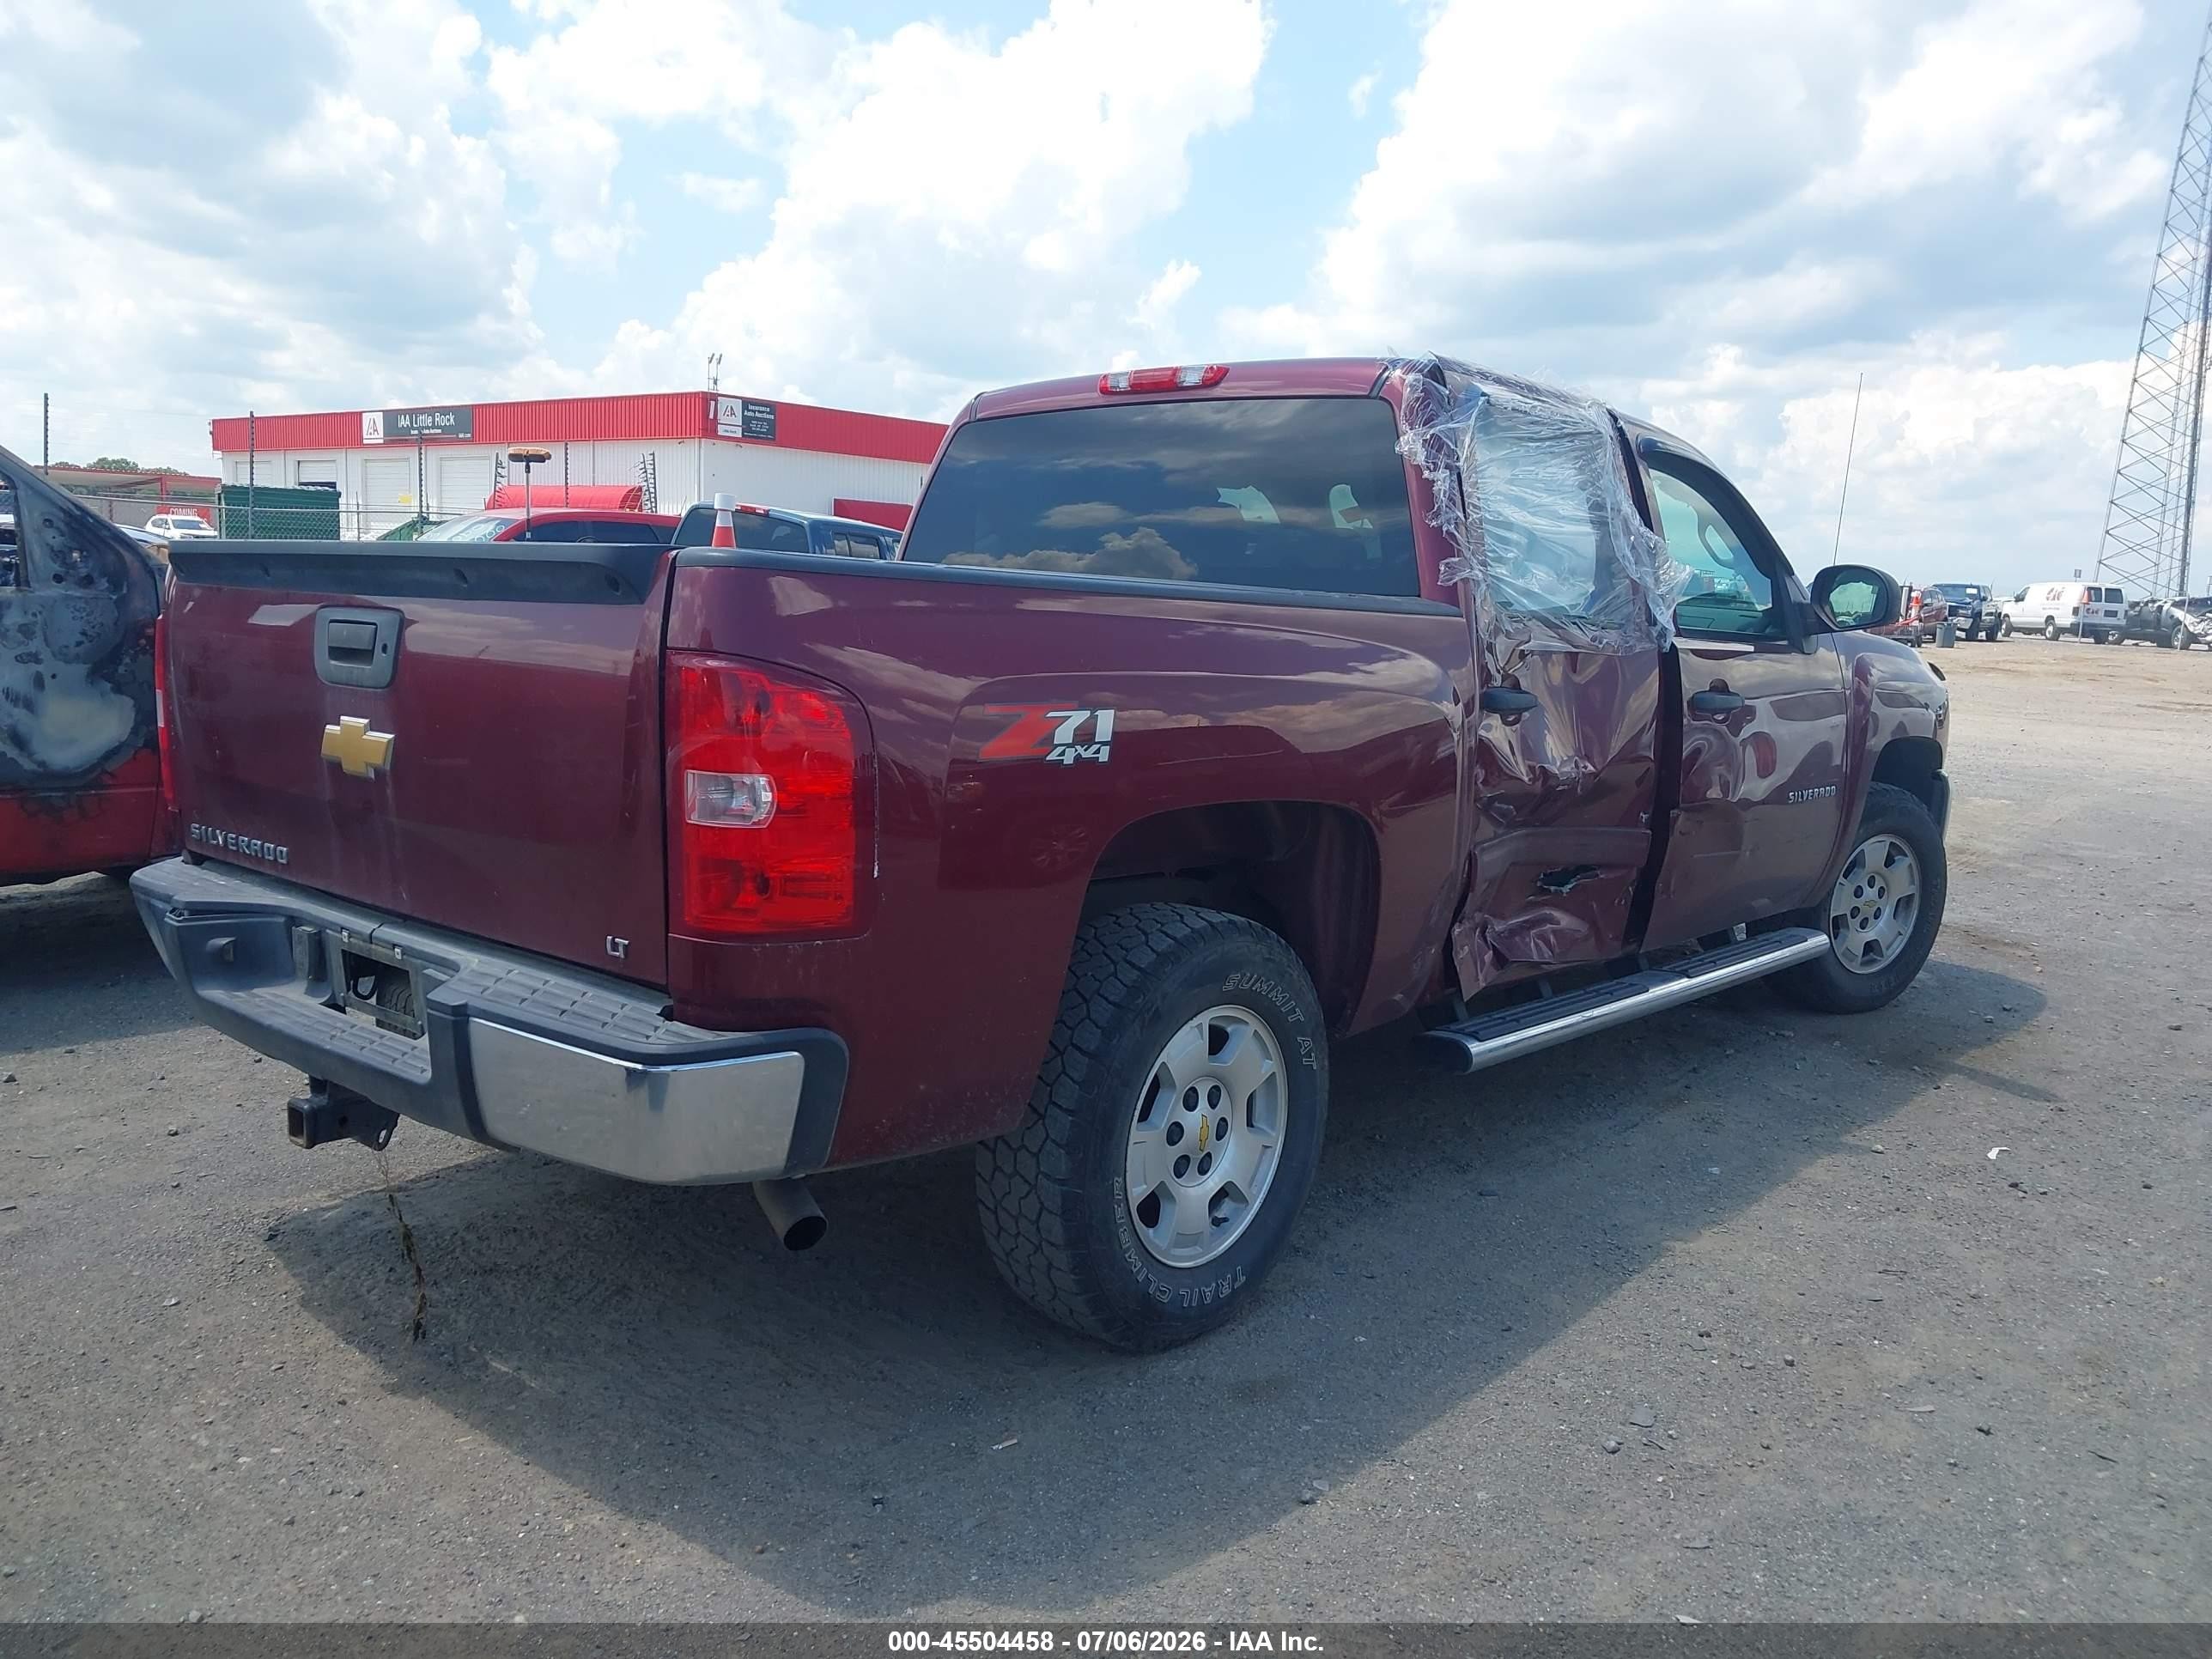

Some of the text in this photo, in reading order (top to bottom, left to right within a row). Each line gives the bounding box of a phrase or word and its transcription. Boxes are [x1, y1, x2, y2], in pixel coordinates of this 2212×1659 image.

[748, 404, 770, 412] Insurance
[756, 411, 775, 420] Auctions
[398, 412, 455, 428] IAA Little Rock
[170, 507, 198, 517] COMING
[979, 702, 1115, 760] Z71
[1789, 786, 1836, 804] SILVERADO
[191, 823, 289, 864] SILVERADO
[605, 935, 629, 959] LT
[1222, 973, 1317, 1070] SUMMIT AT
[1113, 1176, 1247, 1307] TRAIL CLIMBER
